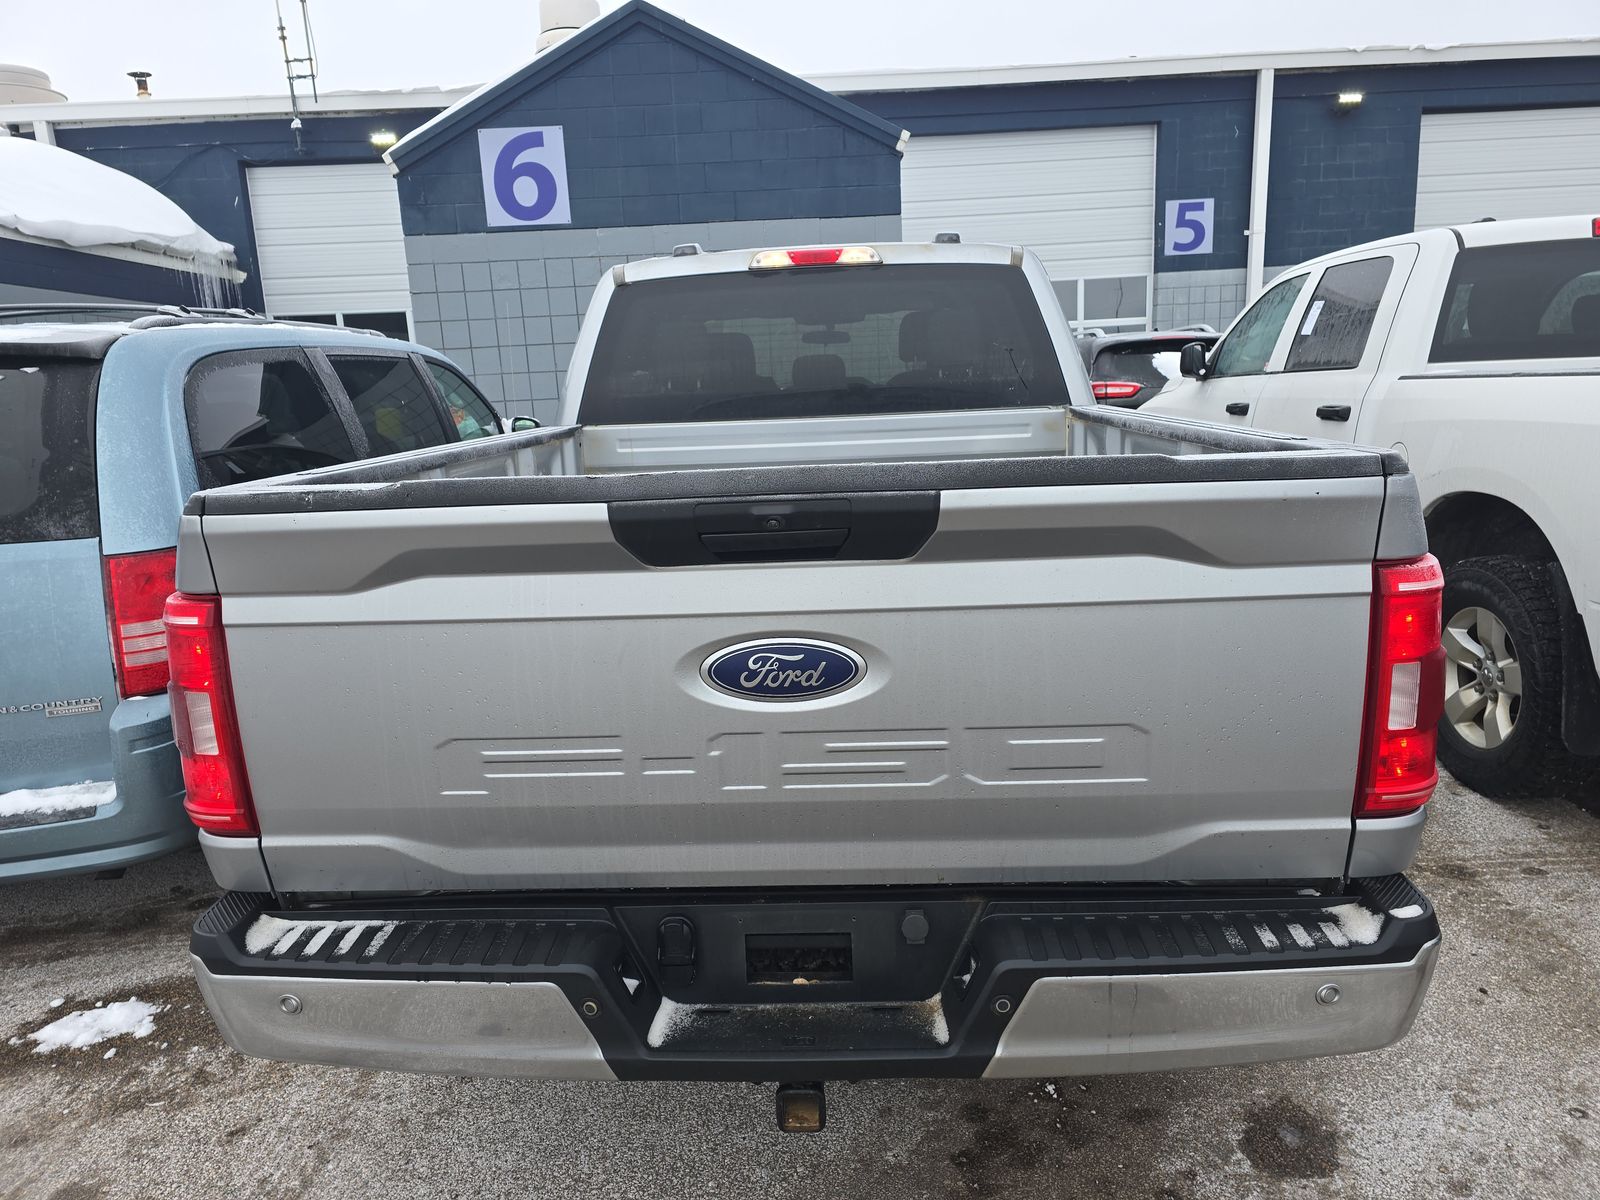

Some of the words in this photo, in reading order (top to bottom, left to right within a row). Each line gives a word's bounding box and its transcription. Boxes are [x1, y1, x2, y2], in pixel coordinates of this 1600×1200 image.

[493, 131, 558, 222] 6
[1172, 201, 1206, 252] 5
[740, 653, 827, 688] Ford
[20, 696, 103, 712] COUNTRY
[52, 706, 95, 715] TOURING
[435, 722, 1151, 795] F-150
